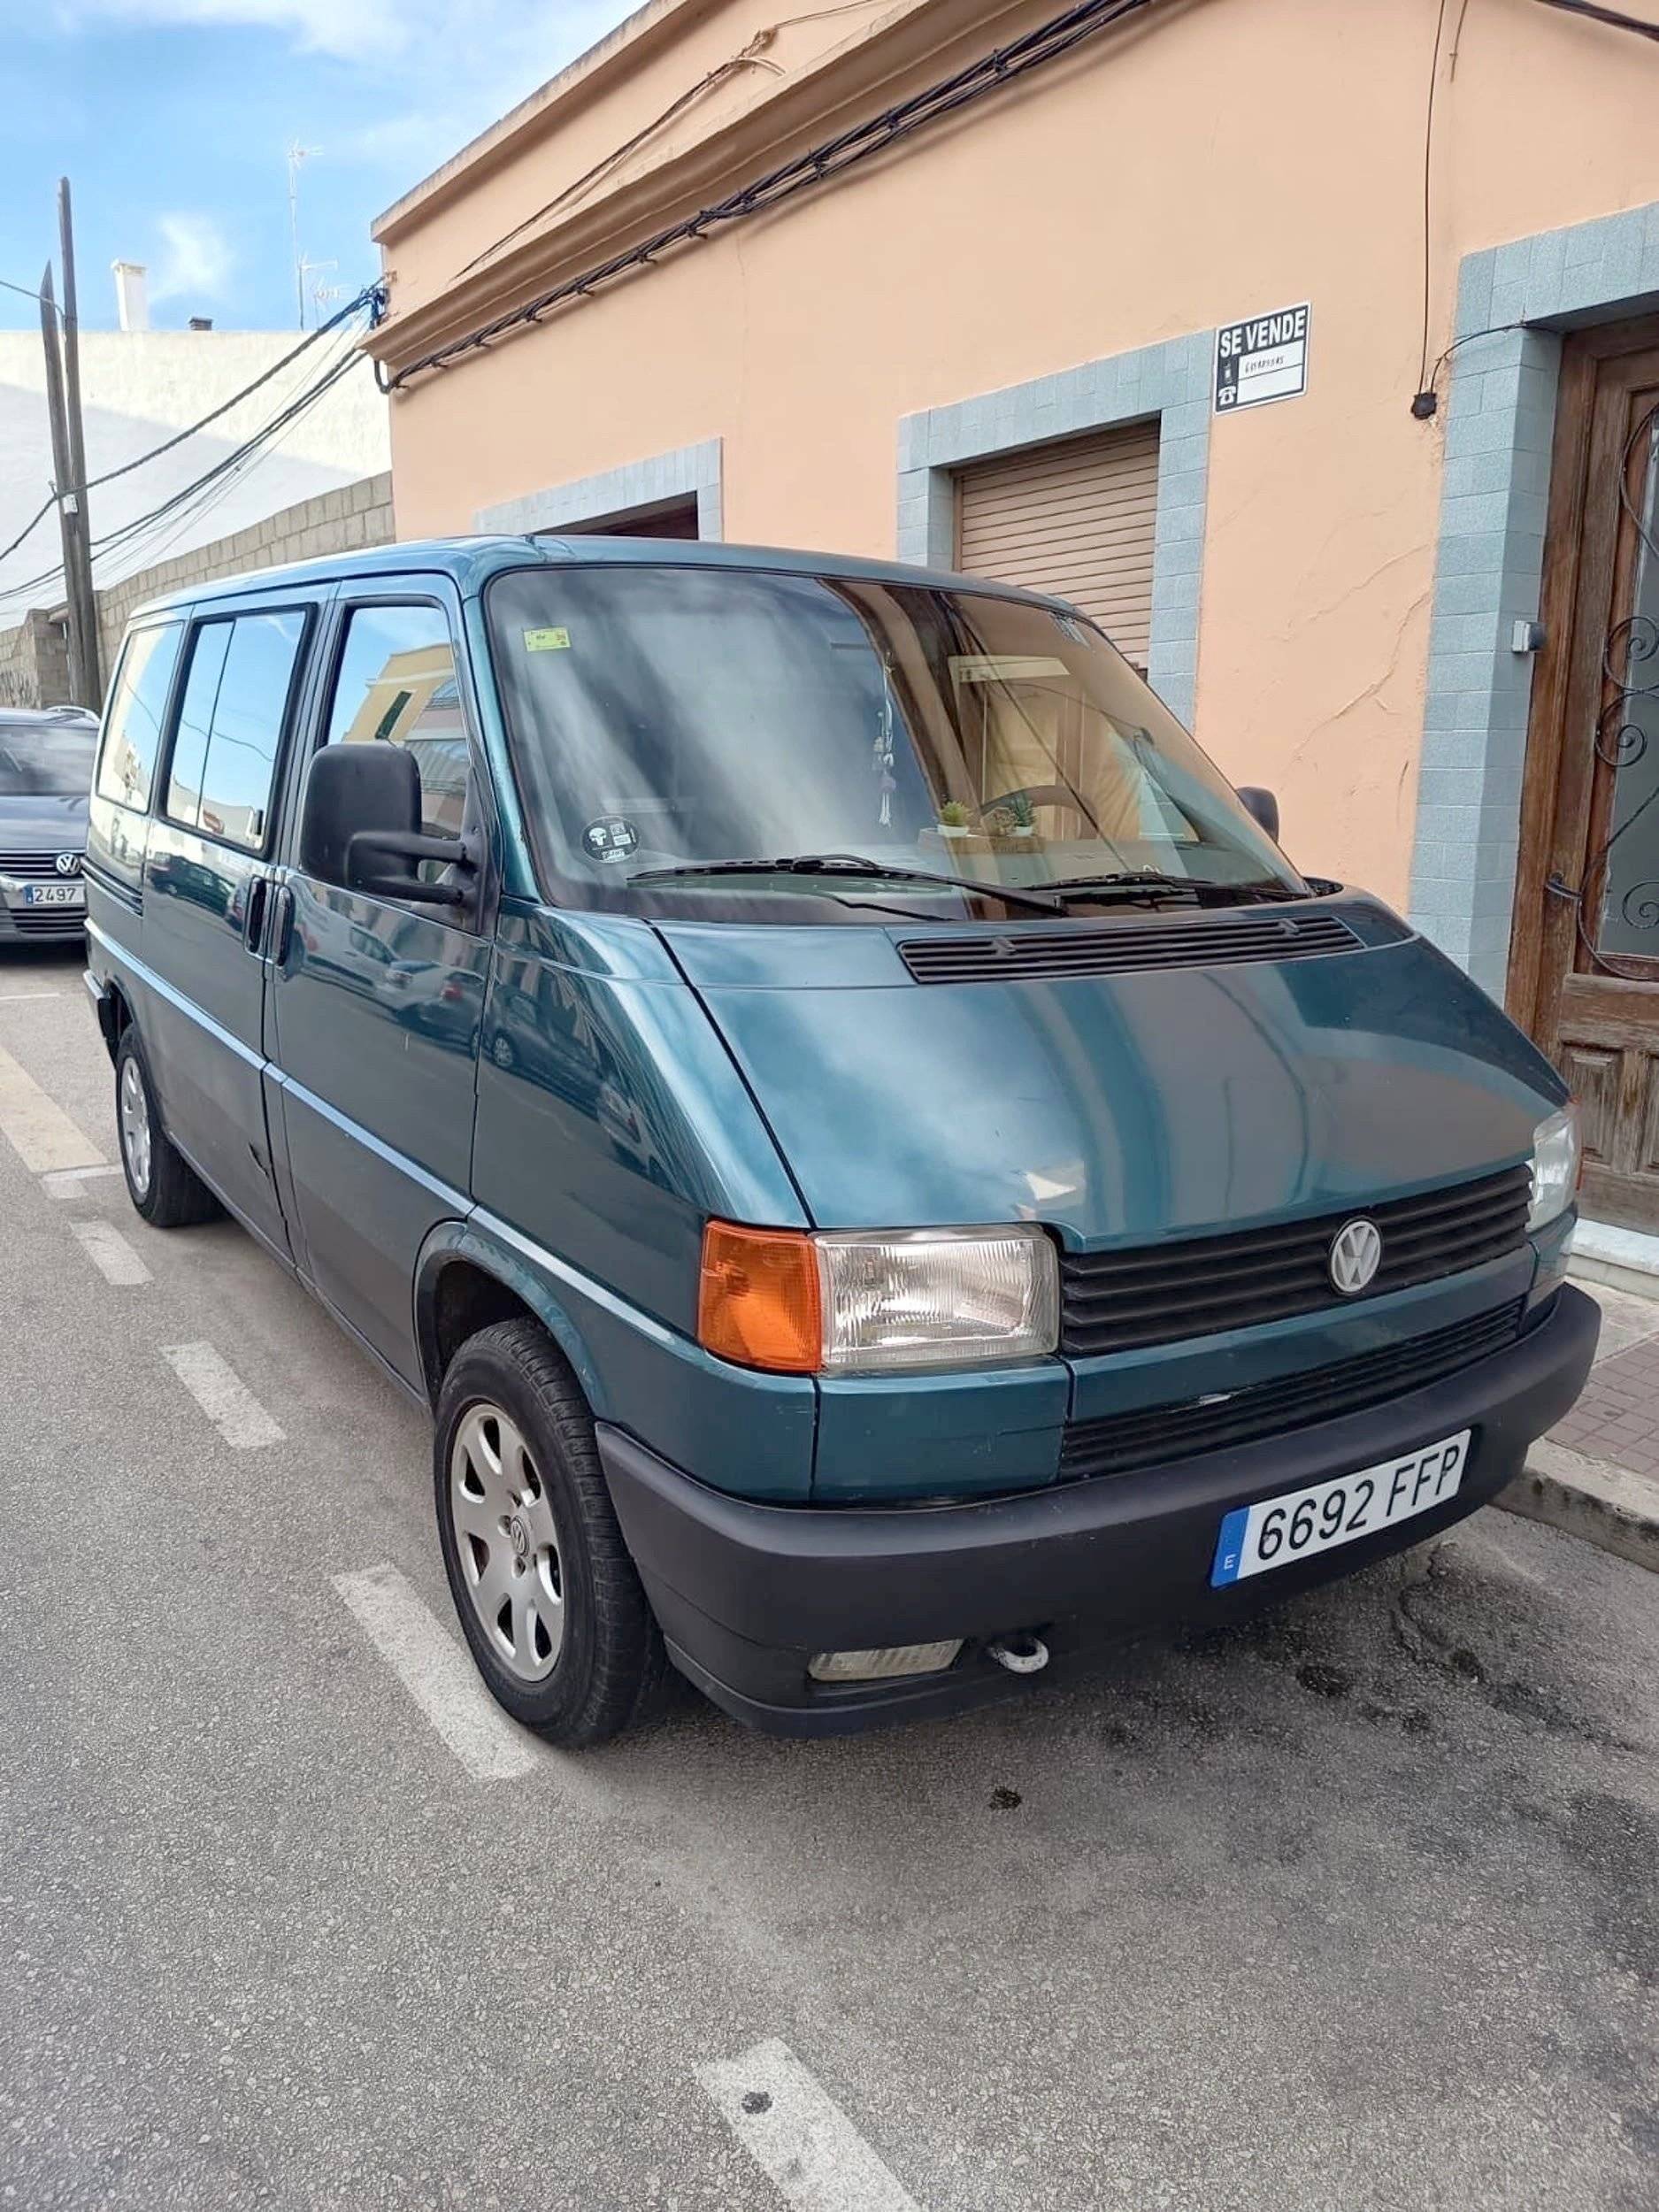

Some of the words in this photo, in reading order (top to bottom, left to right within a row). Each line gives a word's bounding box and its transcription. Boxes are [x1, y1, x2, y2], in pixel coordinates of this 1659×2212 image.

[1220, 327, 1242, 357] SE
[1246, 309, 1306, 350] VENDE
[35, 887, 76, 902] 2497
[1331, 1221, 1380, 1292] VW
[1257, 1479, 1375, 1560] 6692
[1386, 1445, 1460, 1517] FFP
[1224, 1554, 1237, 1571] E
